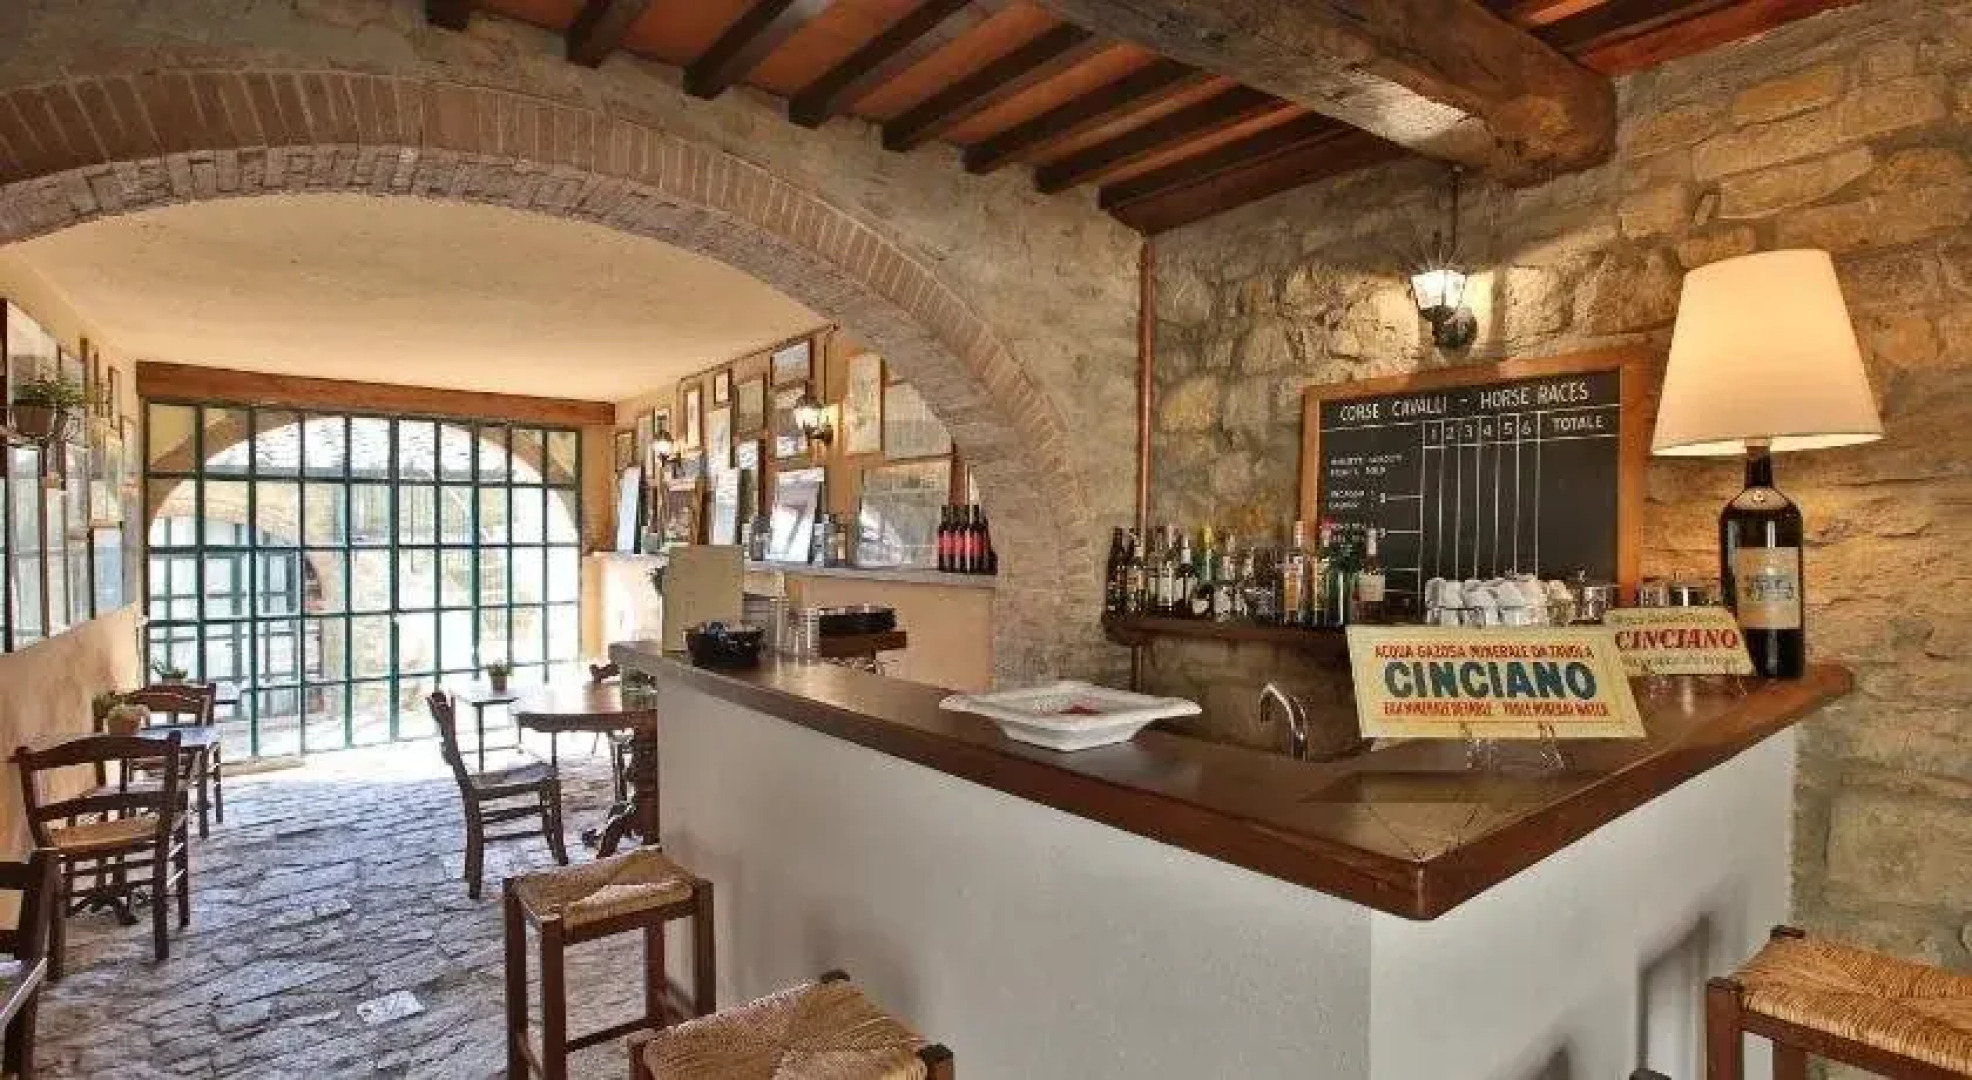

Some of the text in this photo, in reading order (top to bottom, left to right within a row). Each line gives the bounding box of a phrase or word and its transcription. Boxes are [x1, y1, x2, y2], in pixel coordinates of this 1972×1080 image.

[1340, 403, 1379, 421] CORSE
[1391, 395, 1447, 417] CAVALLI
[1480, 386, 1531, 409] HORSE
[1538, 382, 1588, 405] RACES
[1445, 426, 1454, 440] 2
[1464, 424, 1473, 438] 3
[1483, 424, 1492, 437] 4
[1504, 422, 1513, 435] 5
[1521, 420, 1532, 435] 6
[1552, 415, 1604, 433] TOTALE
[1375, 645, 1413, 658] ACQUA
[1417, 645, 1465, 658] GAZOSA
[1469, 645, 1527, 658] MINERALE
[1614, 628, 1738, 650] CINCIANO
[1384, 661, 1597, 700] CINCIANO
